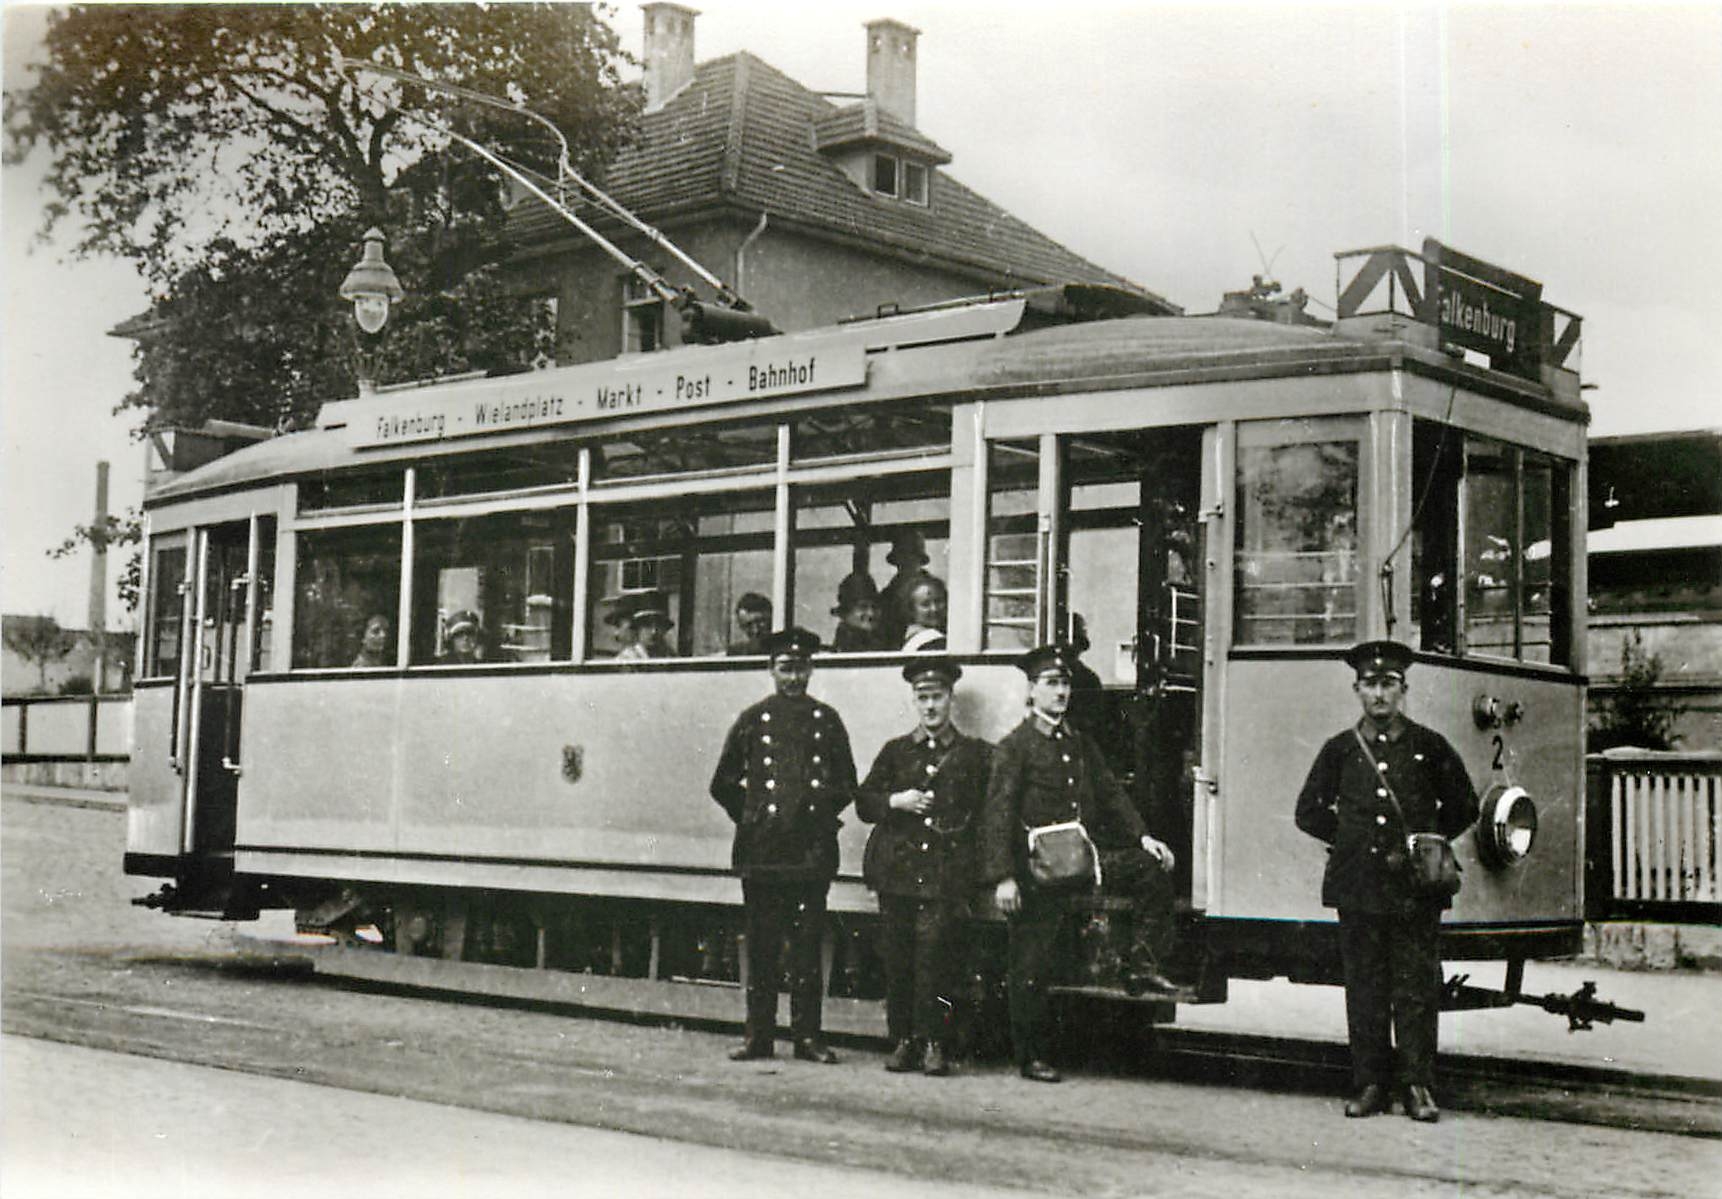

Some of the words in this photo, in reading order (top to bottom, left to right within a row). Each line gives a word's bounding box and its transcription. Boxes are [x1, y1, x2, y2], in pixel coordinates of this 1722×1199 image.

[1437, 285, 1516, 353] alkenburg
[376, 413, 446, 440] Falkenburg
[475, 397, 563, 425] Wielandplatz
[597, 384, 642, 410] Markt
[676, 375, 710, 399] Post
[749, 357, 815, 391] Bahnhof
[1491, 735, 1503, 770] 2
